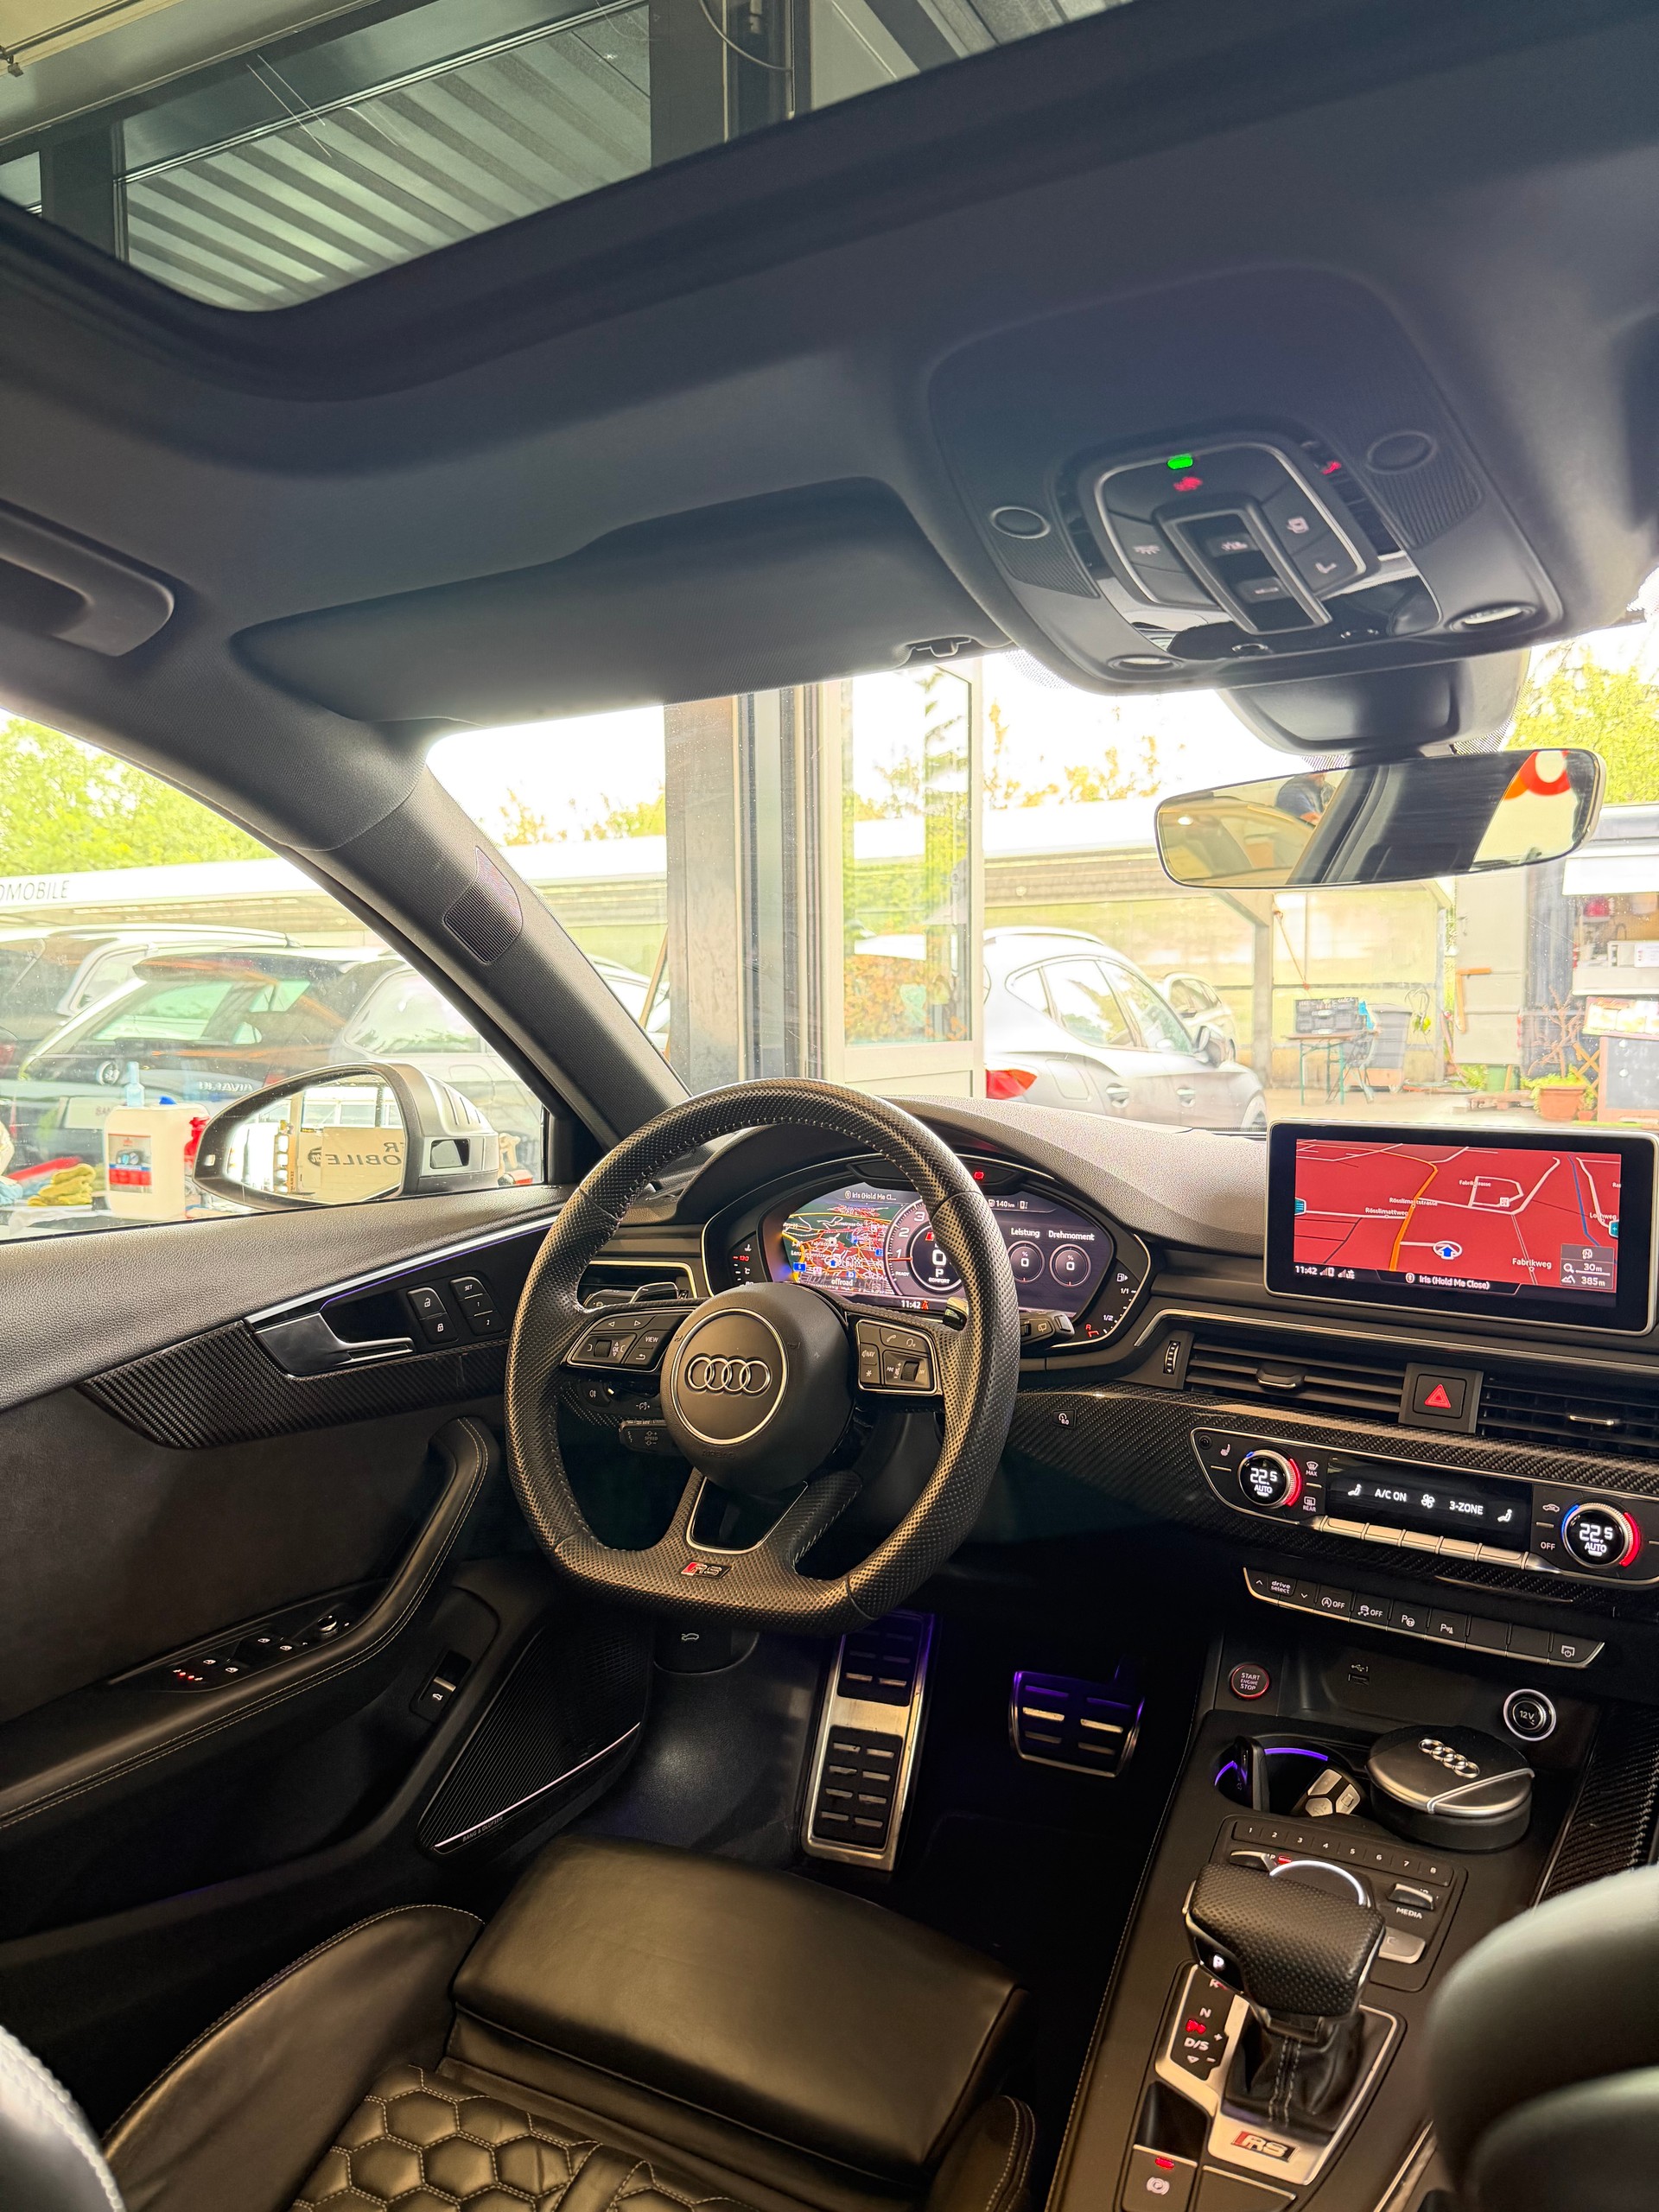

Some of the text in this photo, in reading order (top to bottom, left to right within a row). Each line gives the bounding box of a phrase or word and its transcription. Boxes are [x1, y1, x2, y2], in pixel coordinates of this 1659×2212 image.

[914, 1211, 925, 1222] 3
[899, 1228, 909, 1238] 2
[1011, 1227, 1040, 1238] Leistung
[1048, 1230, 1095, 1241] Drehmoment
[1512, 1258, 1552, 1269] Fabrikweg
[935, 1268, 944, 1277] P
[1295, 1266, 1318, 1275] 11:42
[831, 1278, 853, 1287] offroad
[1419, 1274, 1491, 1290] Iris (Hold Me Close)
[901, 1300, 921, 1309] 11:42
[1254, 1484, 1274, 1494] AUTO
[1374, 1488, 1407, 1503] A/C ON
[1449, 1500, 1484, 1516] 3-ZONE
[1540, 1541, 1555, 1550] OFF
[1584, 1542, 1607, 1554] AUTO
[1270, 1585, 1290, 1594] select
[1271, 1580, 1291, 1589] drive
[1332, 1600, 1345, 1609] OFF
[1370, 1609, 1383, 1618] OFF
[1241, 1672, 1261, 1681] START
[1395, 1907, 1423, 1919] MEDIA
[1199, 2007, 1211, 2018] N
[1184, 2037, 1210, 2050] D/S
[1238, 2133, 1291, 2158] RS
